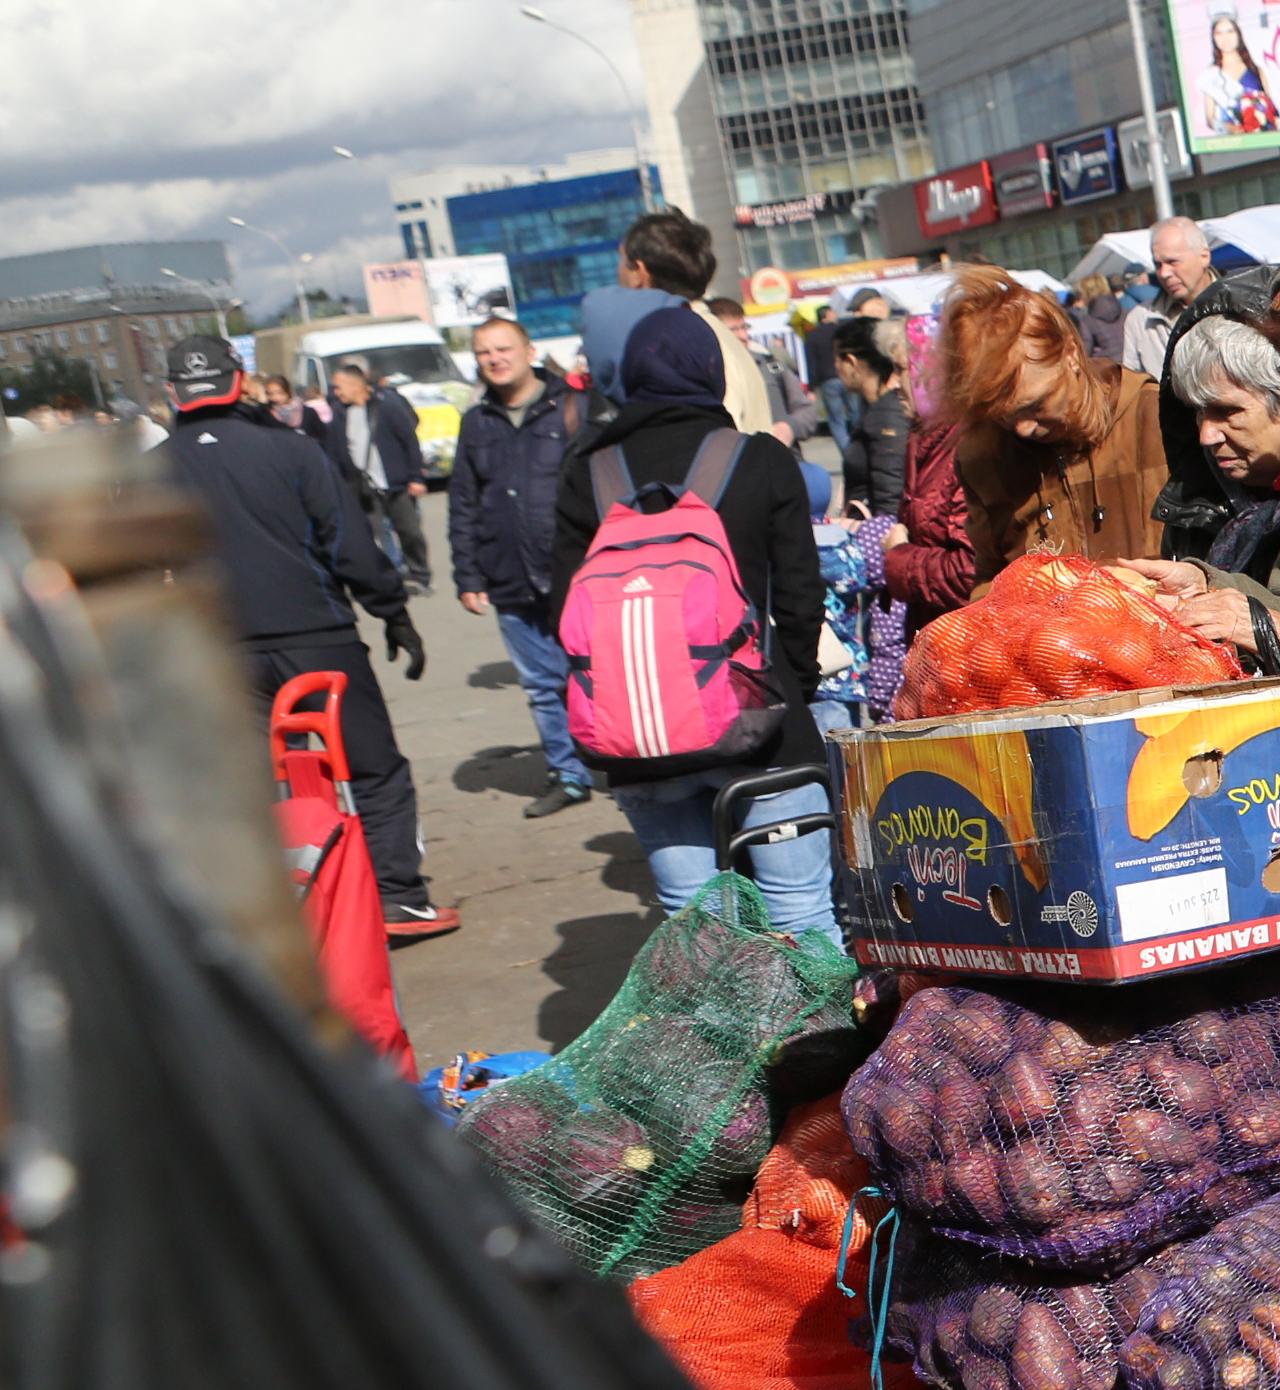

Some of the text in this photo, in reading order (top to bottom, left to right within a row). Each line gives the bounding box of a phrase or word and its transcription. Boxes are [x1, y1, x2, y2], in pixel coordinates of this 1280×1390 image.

[878, 804, 988, 867] Bananas
[1115, 858, 1147, 869] BANANAS
[1147, 852, 1178, 864] PREMIUM
[1151, 854, 1223, 873] Variety: CAVENDISH
[1179, 849, 1199, 859] EXTRA
[906, 844, 982, 911] Tecni
[1199, 888, 1220, 906] 225
[1140, 930, 1269, 968] BANANAS
[866, 942, 1083, 976] EXTRA PREMIUM BANANAS
